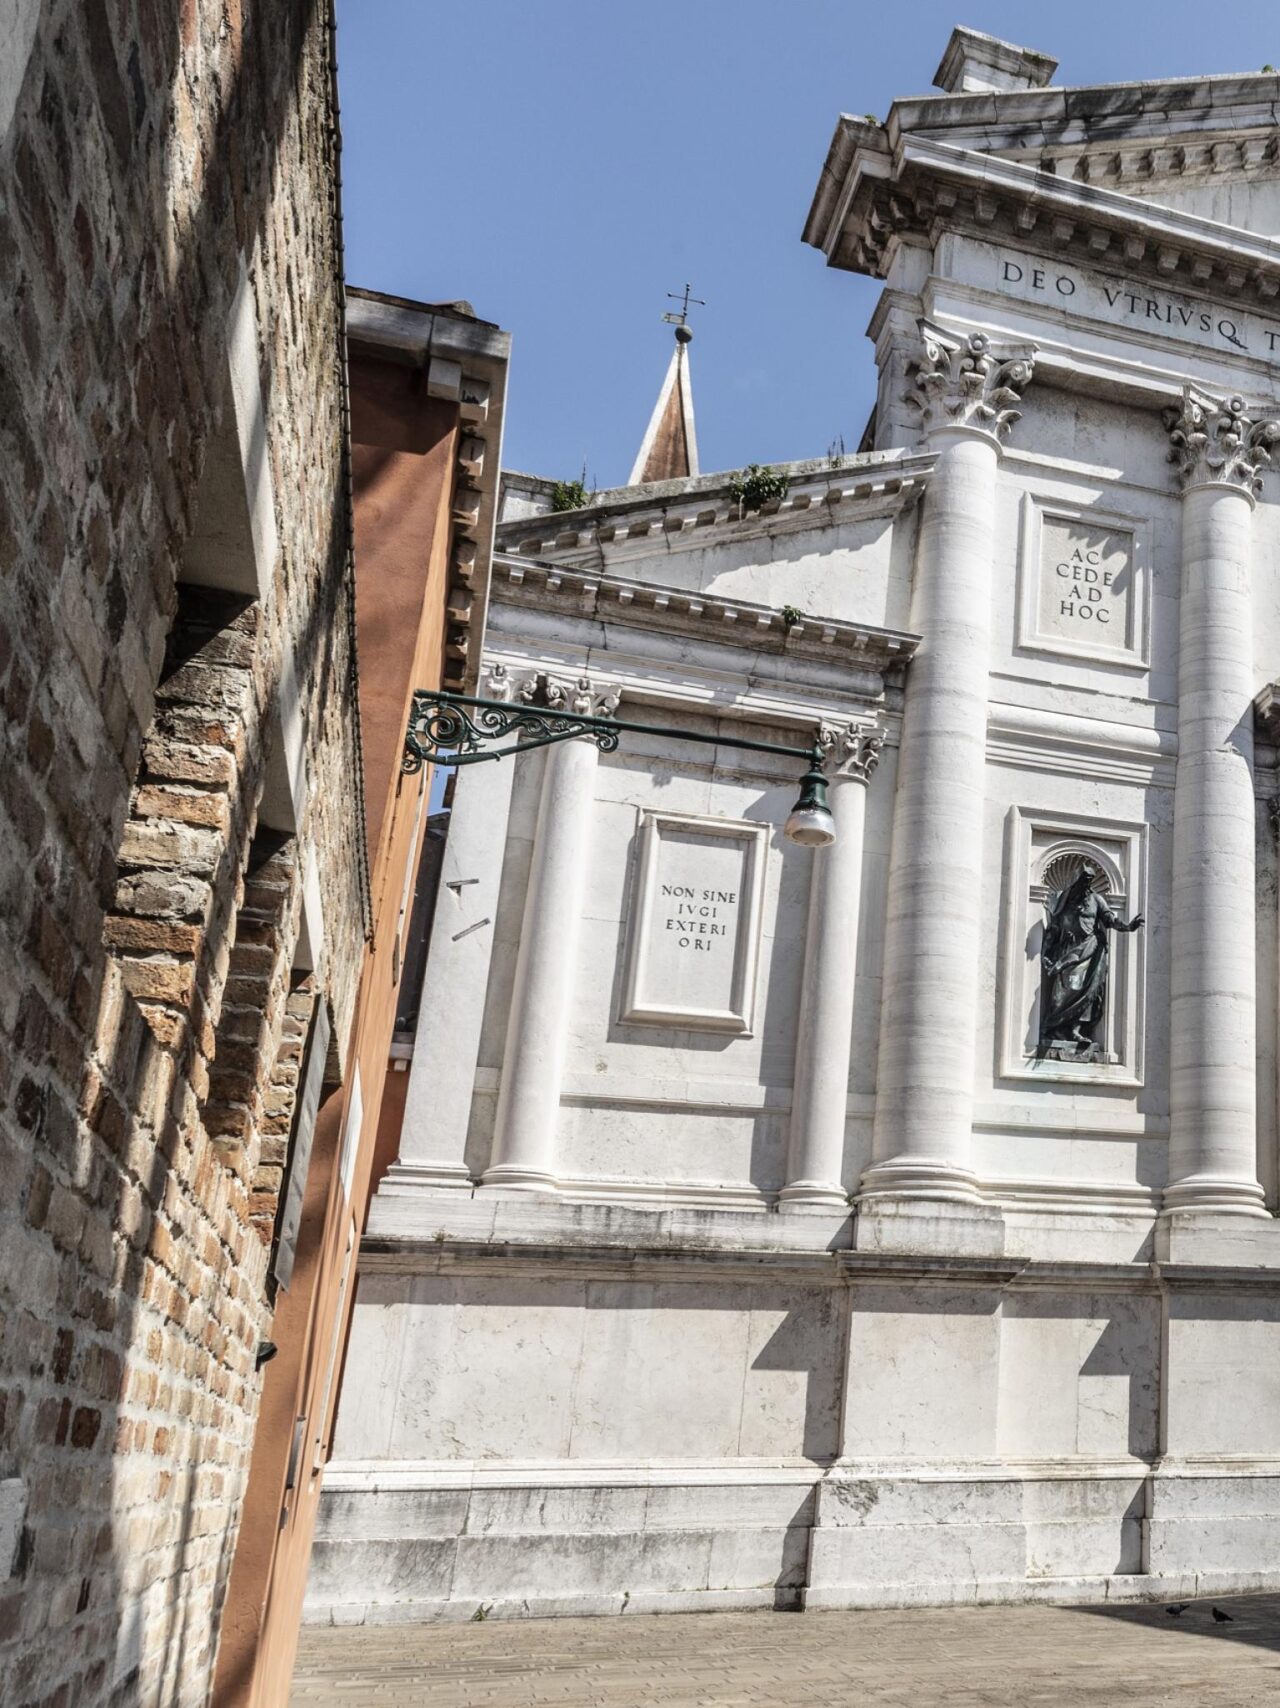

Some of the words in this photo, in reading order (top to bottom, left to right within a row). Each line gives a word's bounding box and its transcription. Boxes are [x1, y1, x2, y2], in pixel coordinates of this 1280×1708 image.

[1002, 261, 1076, 296] DEO
[1071, 548, 1099, 565] AC
[1056, 563, 1112, 586] CEDE
[1068, 584, 1102, 602] AD
[1060, 600, 1110, 623] HOC
[661, 885, 695, 898] NON
[702, 890, 737, 904] SINE
[678, 903, 717, 918] IVGI
[666, 919, 726, 935] EXTERI
[678, 937, 712, 951] ORI
